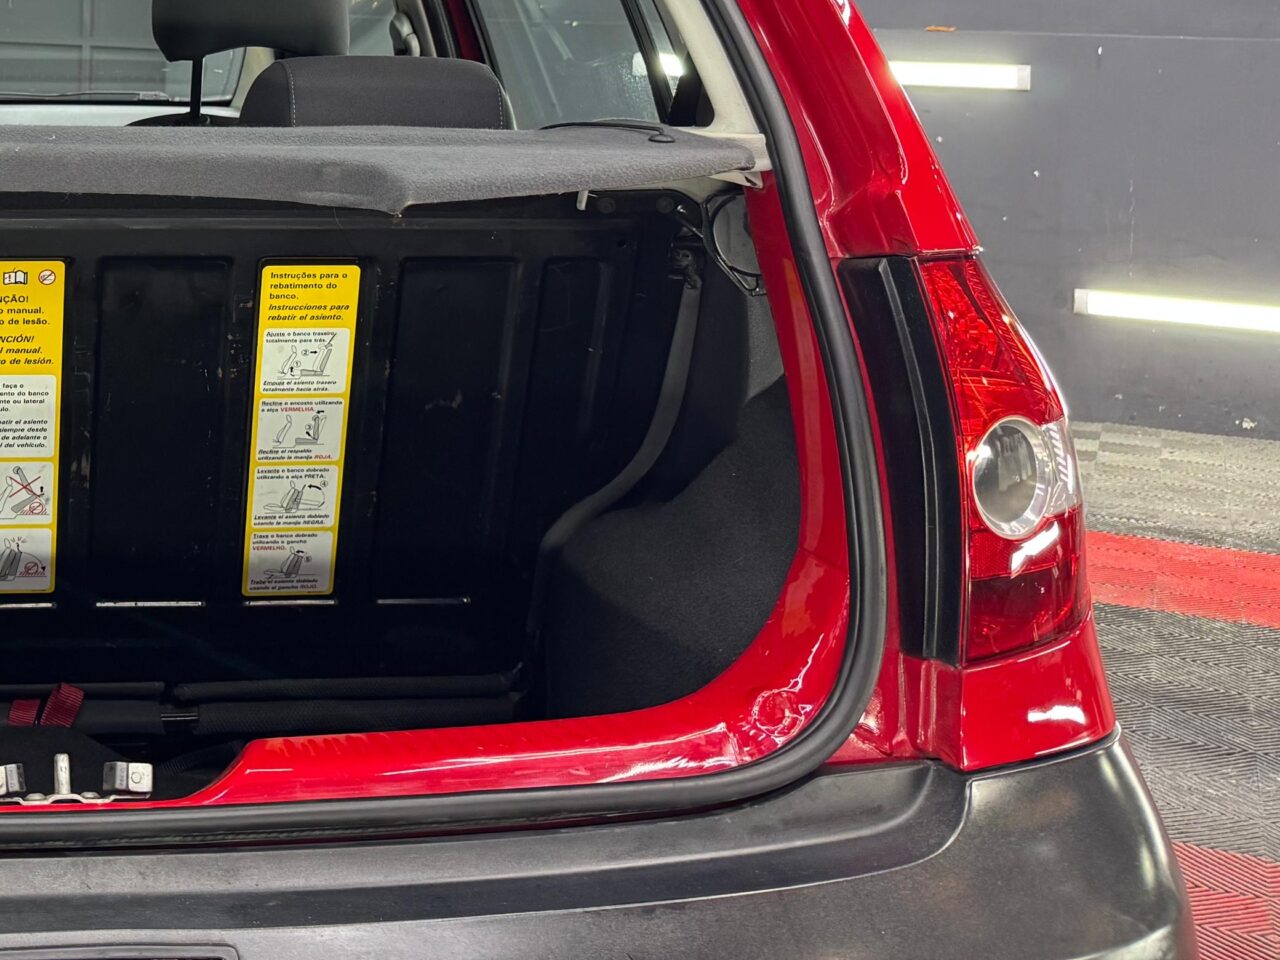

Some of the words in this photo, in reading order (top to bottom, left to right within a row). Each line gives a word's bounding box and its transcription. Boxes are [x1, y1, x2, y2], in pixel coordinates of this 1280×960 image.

[270, 272, 317, 280] Instruções
[22, 317, 50, 325] lesão.
[6, 346, 43, 354] manual.
[10, 357, 21, 365] de
[24, 357, 54, 365] lesión.
